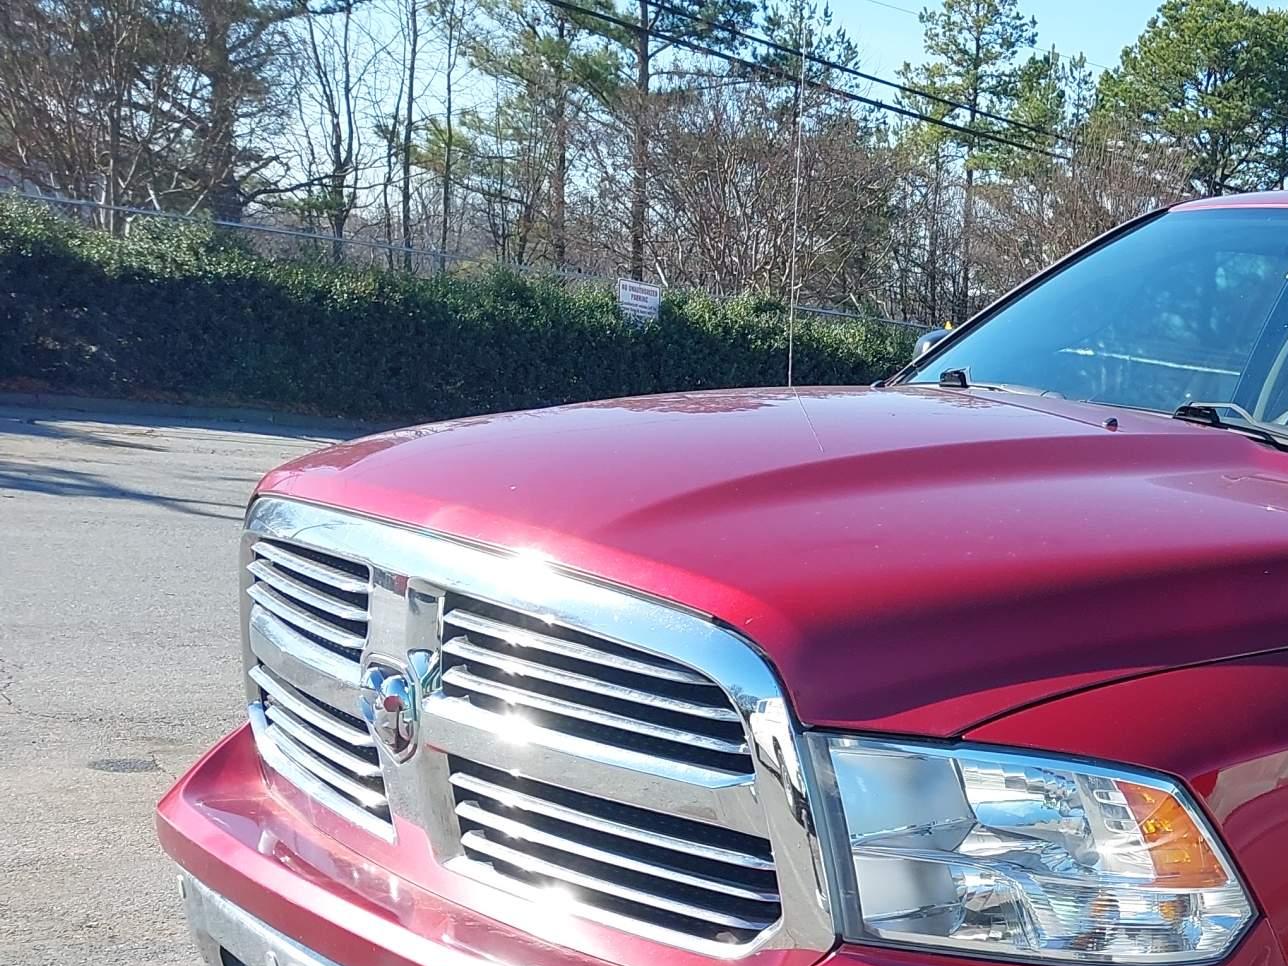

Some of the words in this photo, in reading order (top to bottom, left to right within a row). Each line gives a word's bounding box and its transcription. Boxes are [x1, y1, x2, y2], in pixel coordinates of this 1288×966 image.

[621, 283, 628, 292] NO
[628, 285, 658, 297] UNAUTHORIZED
[630, 293, 649, 303] PARKING
